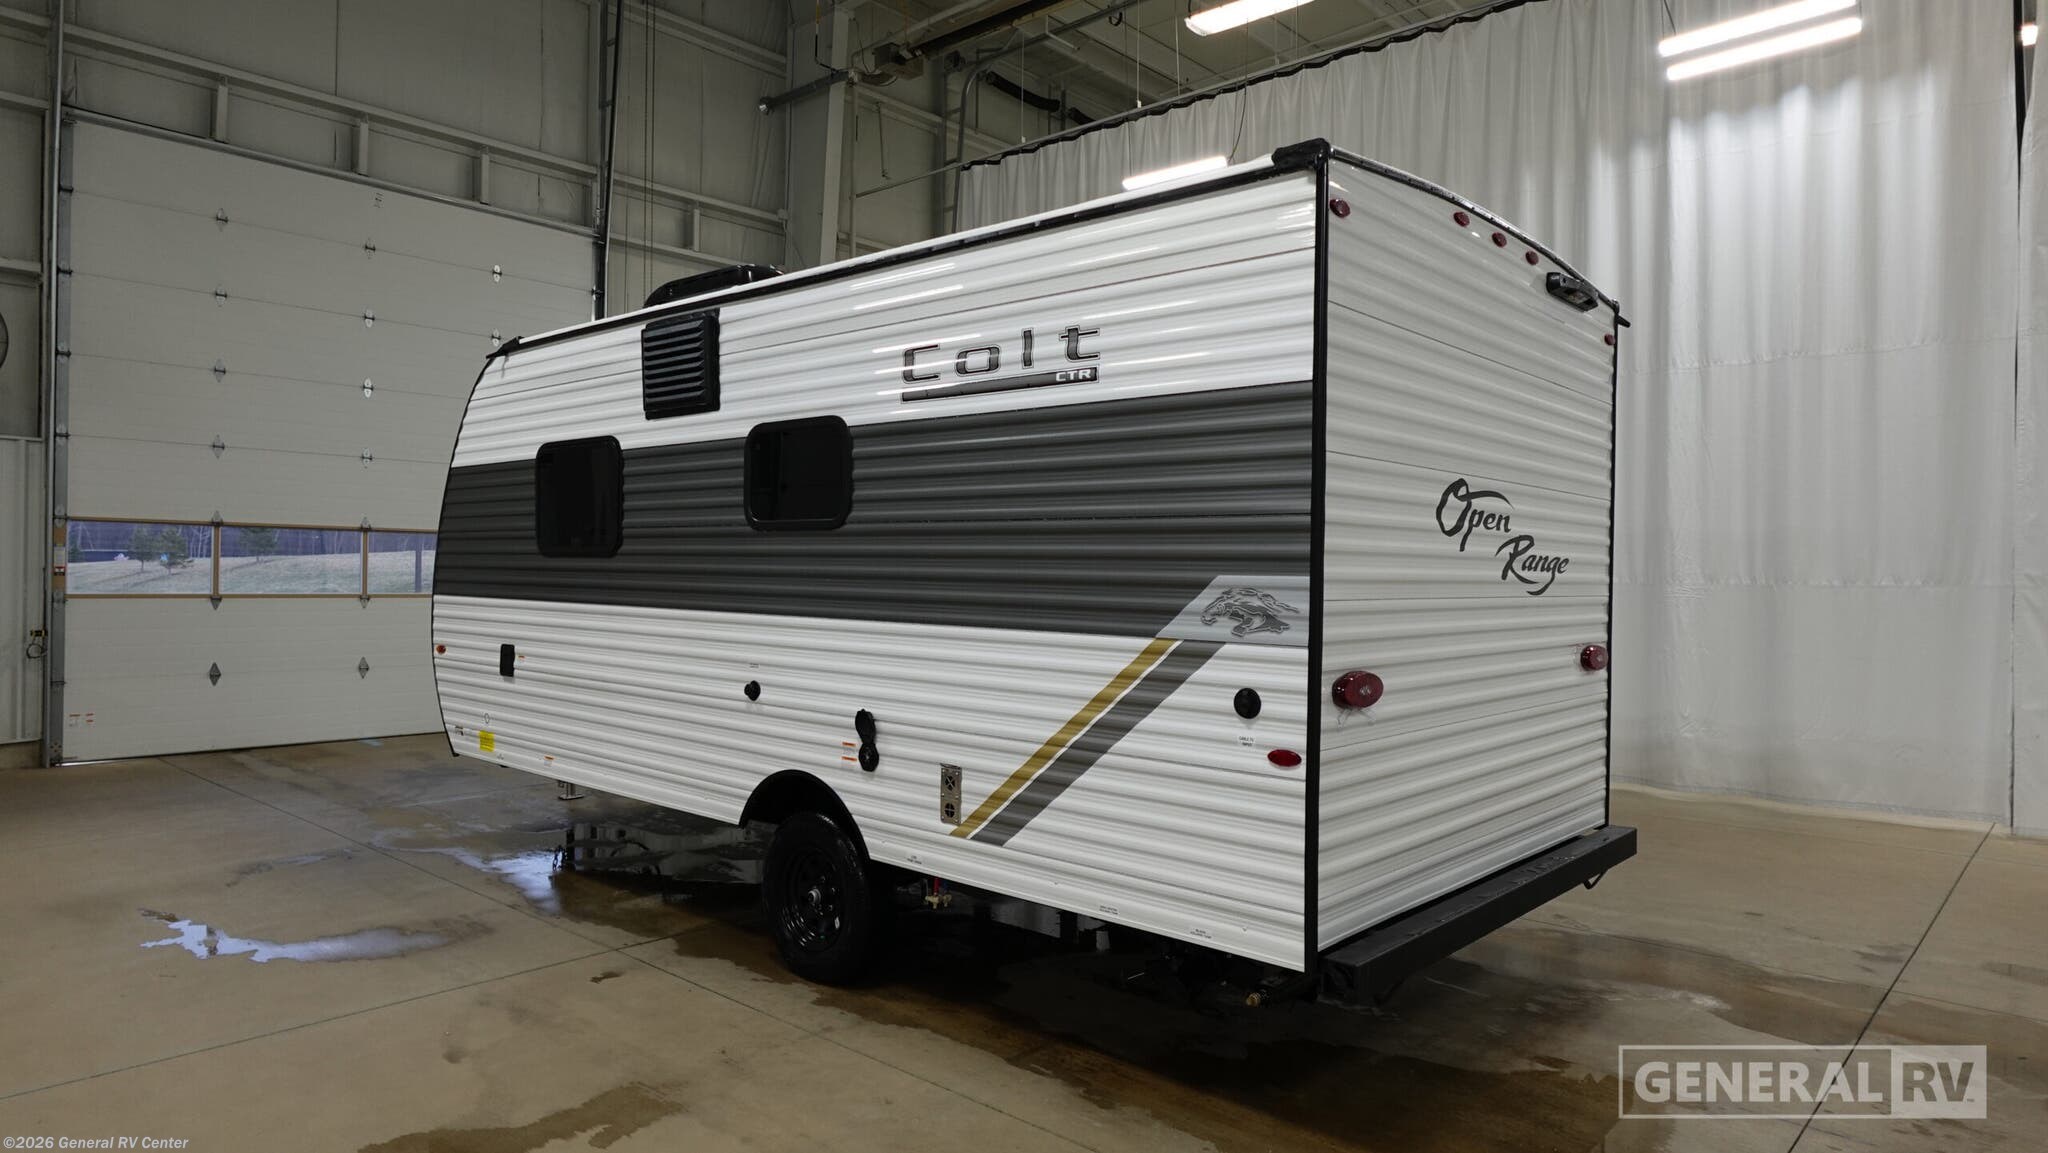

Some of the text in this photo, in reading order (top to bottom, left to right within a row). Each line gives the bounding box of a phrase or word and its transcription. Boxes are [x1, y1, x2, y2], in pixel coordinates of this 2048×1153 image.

[902, 325, 1100, 384] Colt
[1055, 369, 1091, 382] CTR
[1435, 478, 1515, 552] Open
[1495, 534, 1570, 596] Range
